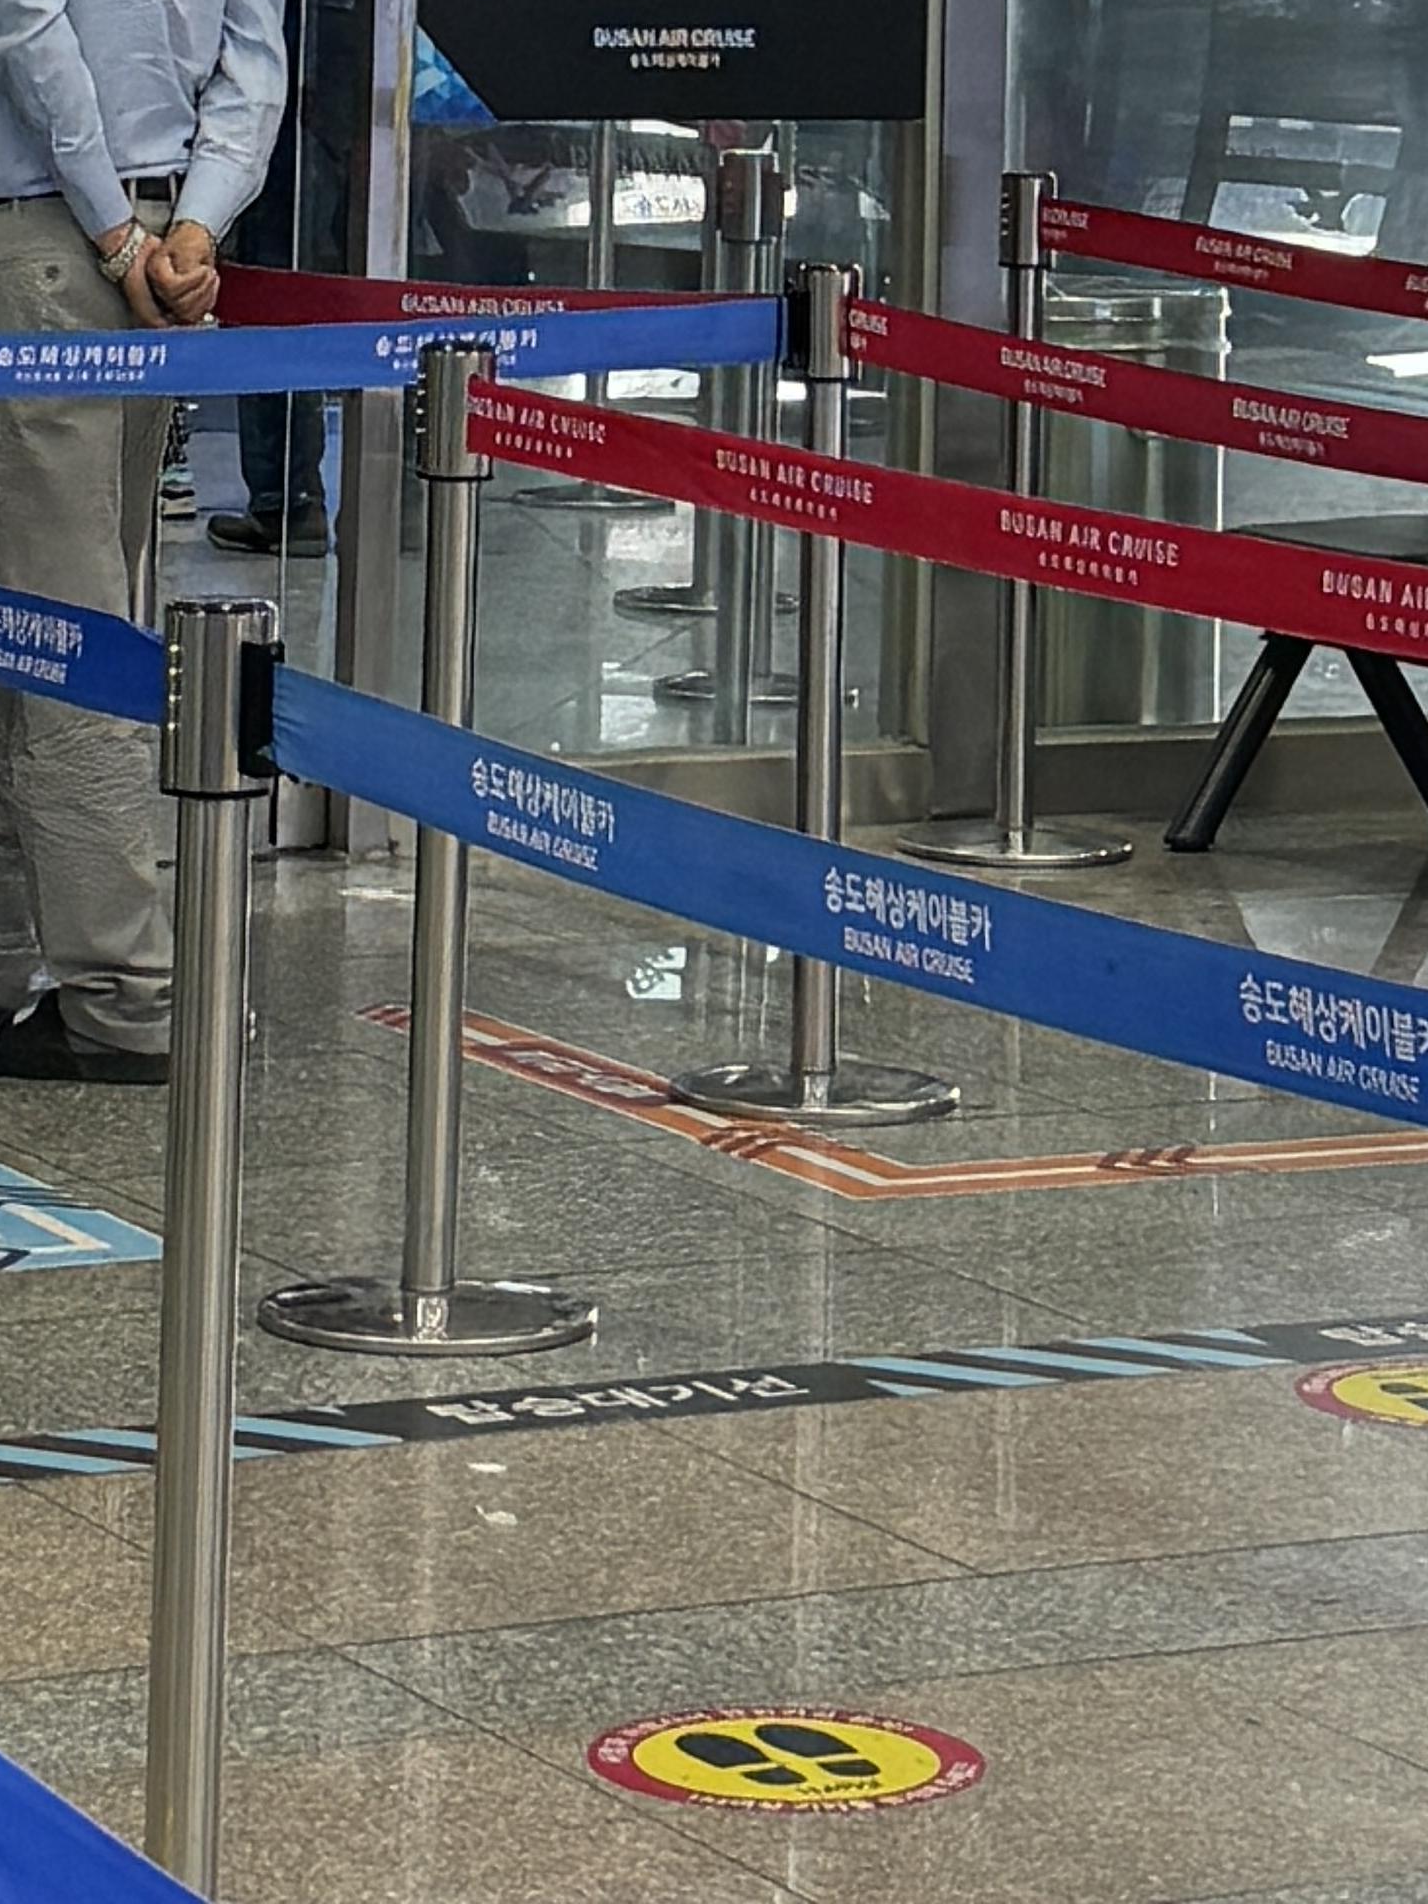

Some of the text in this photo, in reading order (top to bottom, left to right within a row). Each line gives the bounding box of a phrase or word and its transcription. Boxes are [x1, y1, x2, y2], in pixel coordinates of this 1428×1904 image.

[1000, 509, 1180, 567] BUSAN AIR CRUISE
[1322, 569, 1393, 604] BUSAN
[824, 866, 991, 952] 송도해상케이블카
[1266, 1040, 1420, 1104] BUSAN AIR CRUISE
